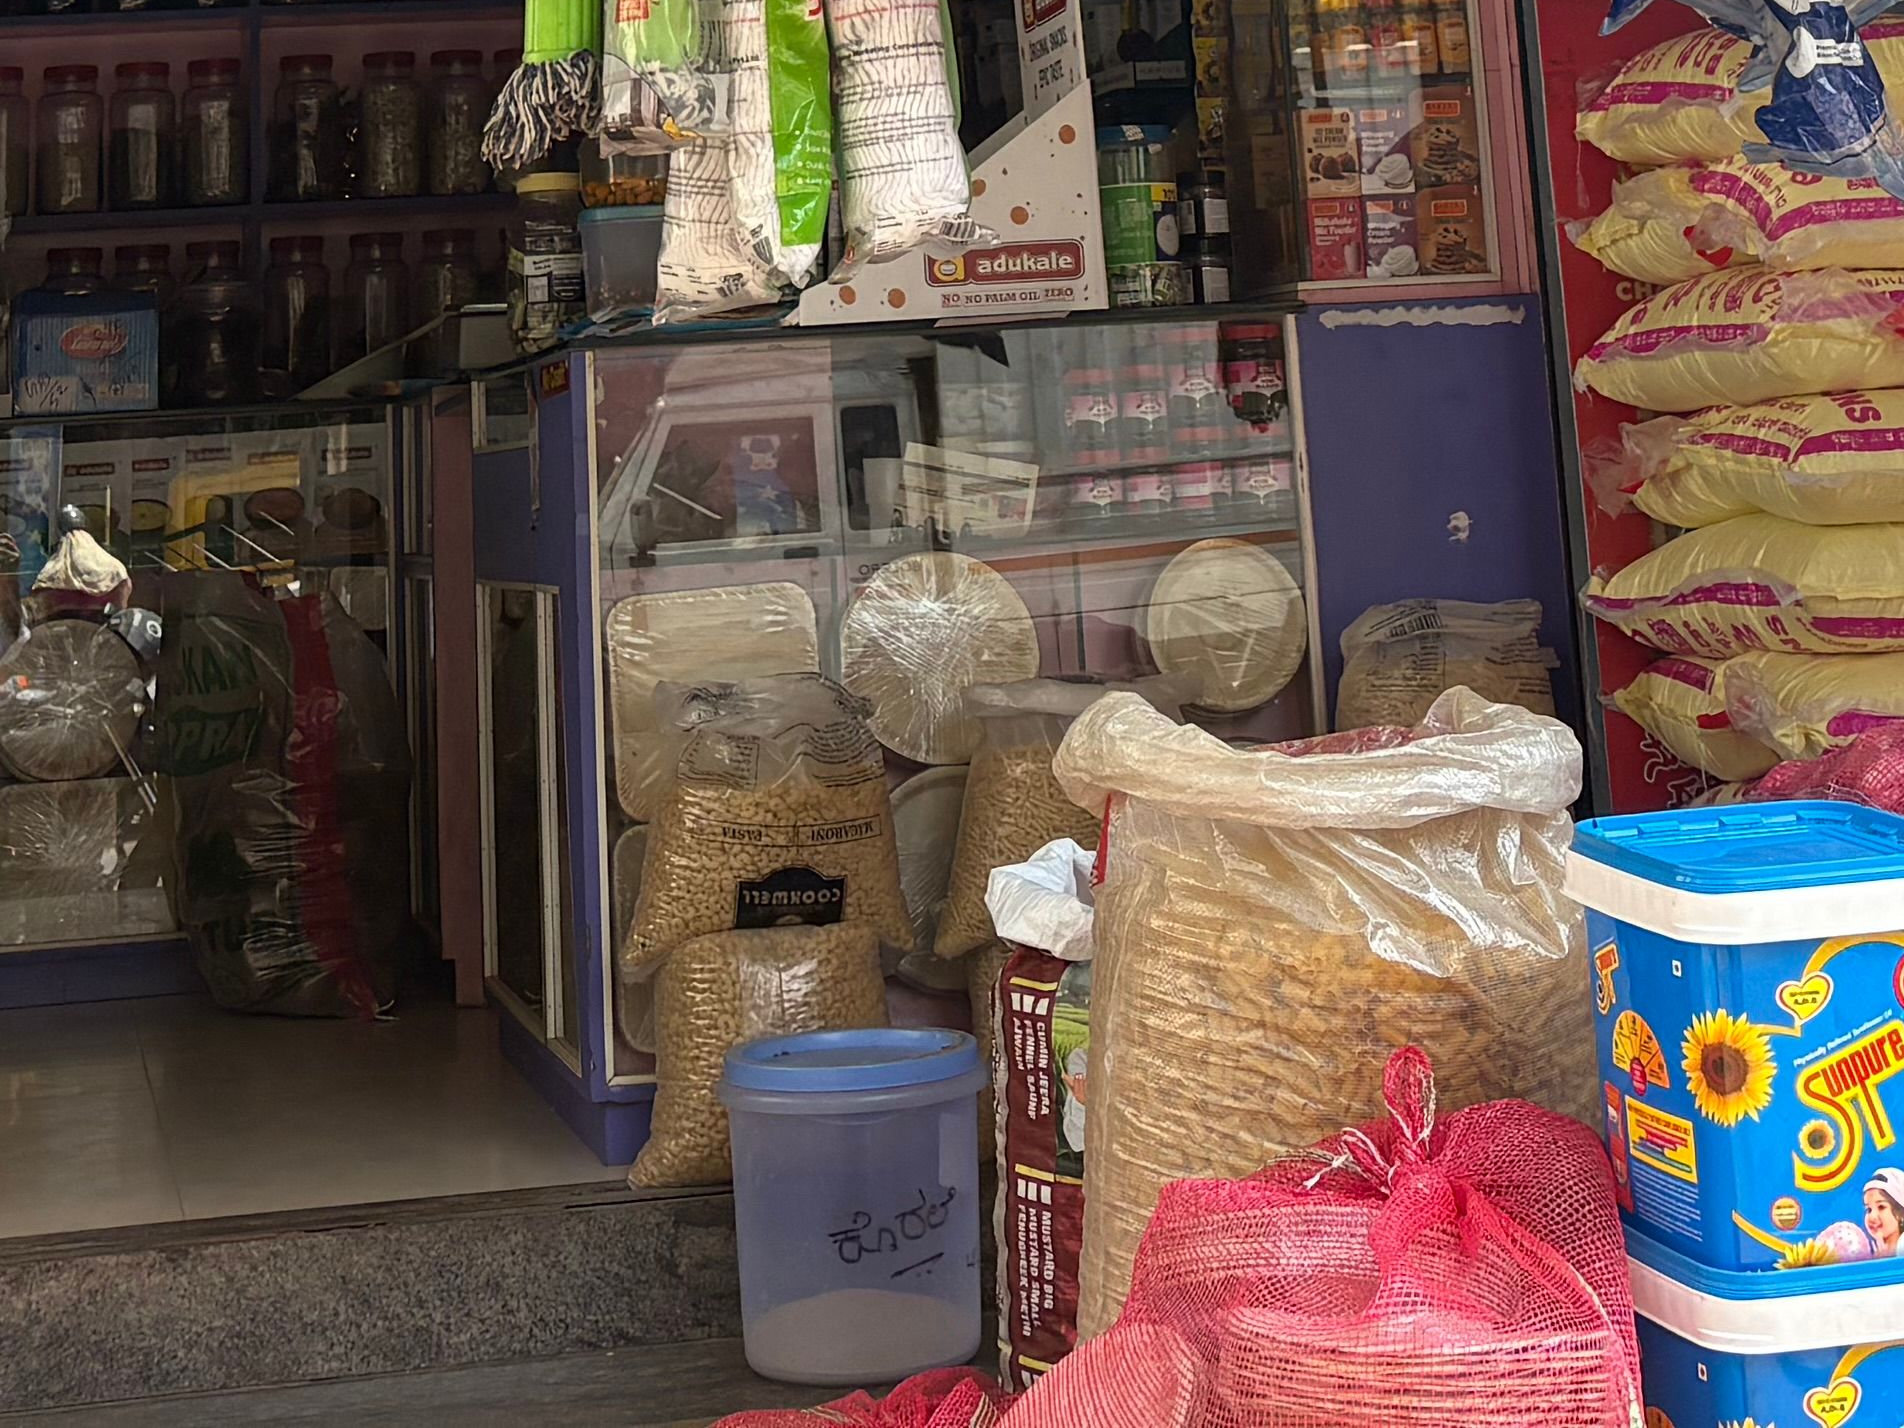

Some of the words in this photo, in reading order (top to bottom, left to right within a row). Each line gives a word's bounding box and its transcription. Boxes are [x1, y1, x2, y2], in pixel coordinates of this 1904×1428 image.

[977, 250, 1075, 276] adukale
[942, 293, 961, 305] NO
[964, 293, 982, 305] NO
[984, 291, 1017, 304] PALM
[1019, 290, 1041, 302] OIL
[1044, 287, 1075, 300] ZERO
[721, 825, 764, 843] PASTA
[809, 820, 876, 844] MACARONI
[741, 886, 842, 908] COOKWELL
[1012, 1016, 1025, 1071] AJWAIN
[1024, 1018, 1036, 1070] FENNEL
[1036, 1020, 1048, 1070] CUMIN
[1026, 1073, 1039, 1121] SAUNF
[1039, 1070, 1051, 1116] JEERA
[1017, 1203, 1029, 1287] FENUGREEK
[1028, 1207, 1040, 1277] MUSTARD
[1040, 1210, 1054, 1280] MUSTARD
[1020, 1290, 1032, 1338] METHI
[1030, 1280, 1042, 1327] SMALL
[1043, 1283, 1054, 1311] BIG
